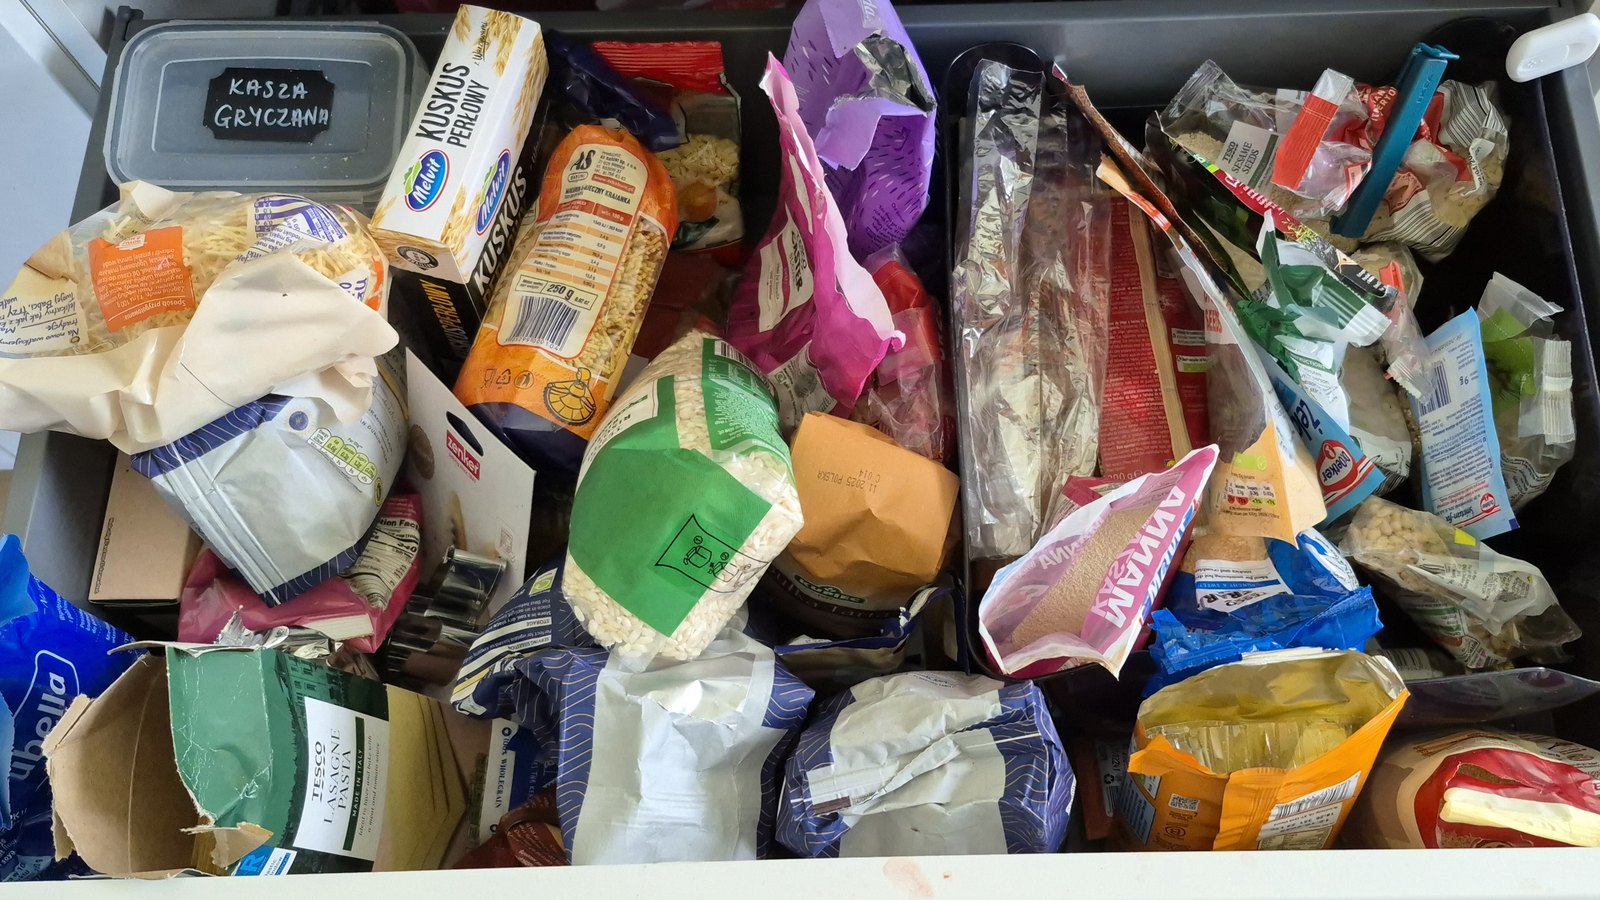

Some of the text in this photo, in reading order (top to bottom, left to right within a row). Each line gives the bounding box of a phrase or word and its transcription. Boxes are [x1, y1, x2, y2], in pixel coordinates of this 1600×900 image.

[229, 78, 309, 100] KASZA
[415, 62, 471, 143] KUSKUS
[214, 104, 329, 128] GRYCZANA
[446, 79, 490, 149] PERŁOWY
[1222, 140, 1238, 163] TESCO
[1231, 142, 1254, 175] SESAME
[1242, 148, 1259, 176] SEEDS
[412, 158, 441, 205] Melvit
[481, 160, 506, 224] Melvit
[474, 166, 527, 296] KUSKUS
[547, 284, 575, 301] 250 g
[448, 436, 479, 475] zenker
[817, 469, 844, 486] POLSKA
[846, 474, 866, 491] 2025
[525, 618, 551, 627] STORAGE
[312, 740, 323, 802] TESCO
[324, 728, 341, 824] LASAGNE
[338, 750, 351, 810] PASTA
[352, 749, 364, 817] MADE IN ITALY
[495, 757, 508, 809] WHOLEGRAIN
